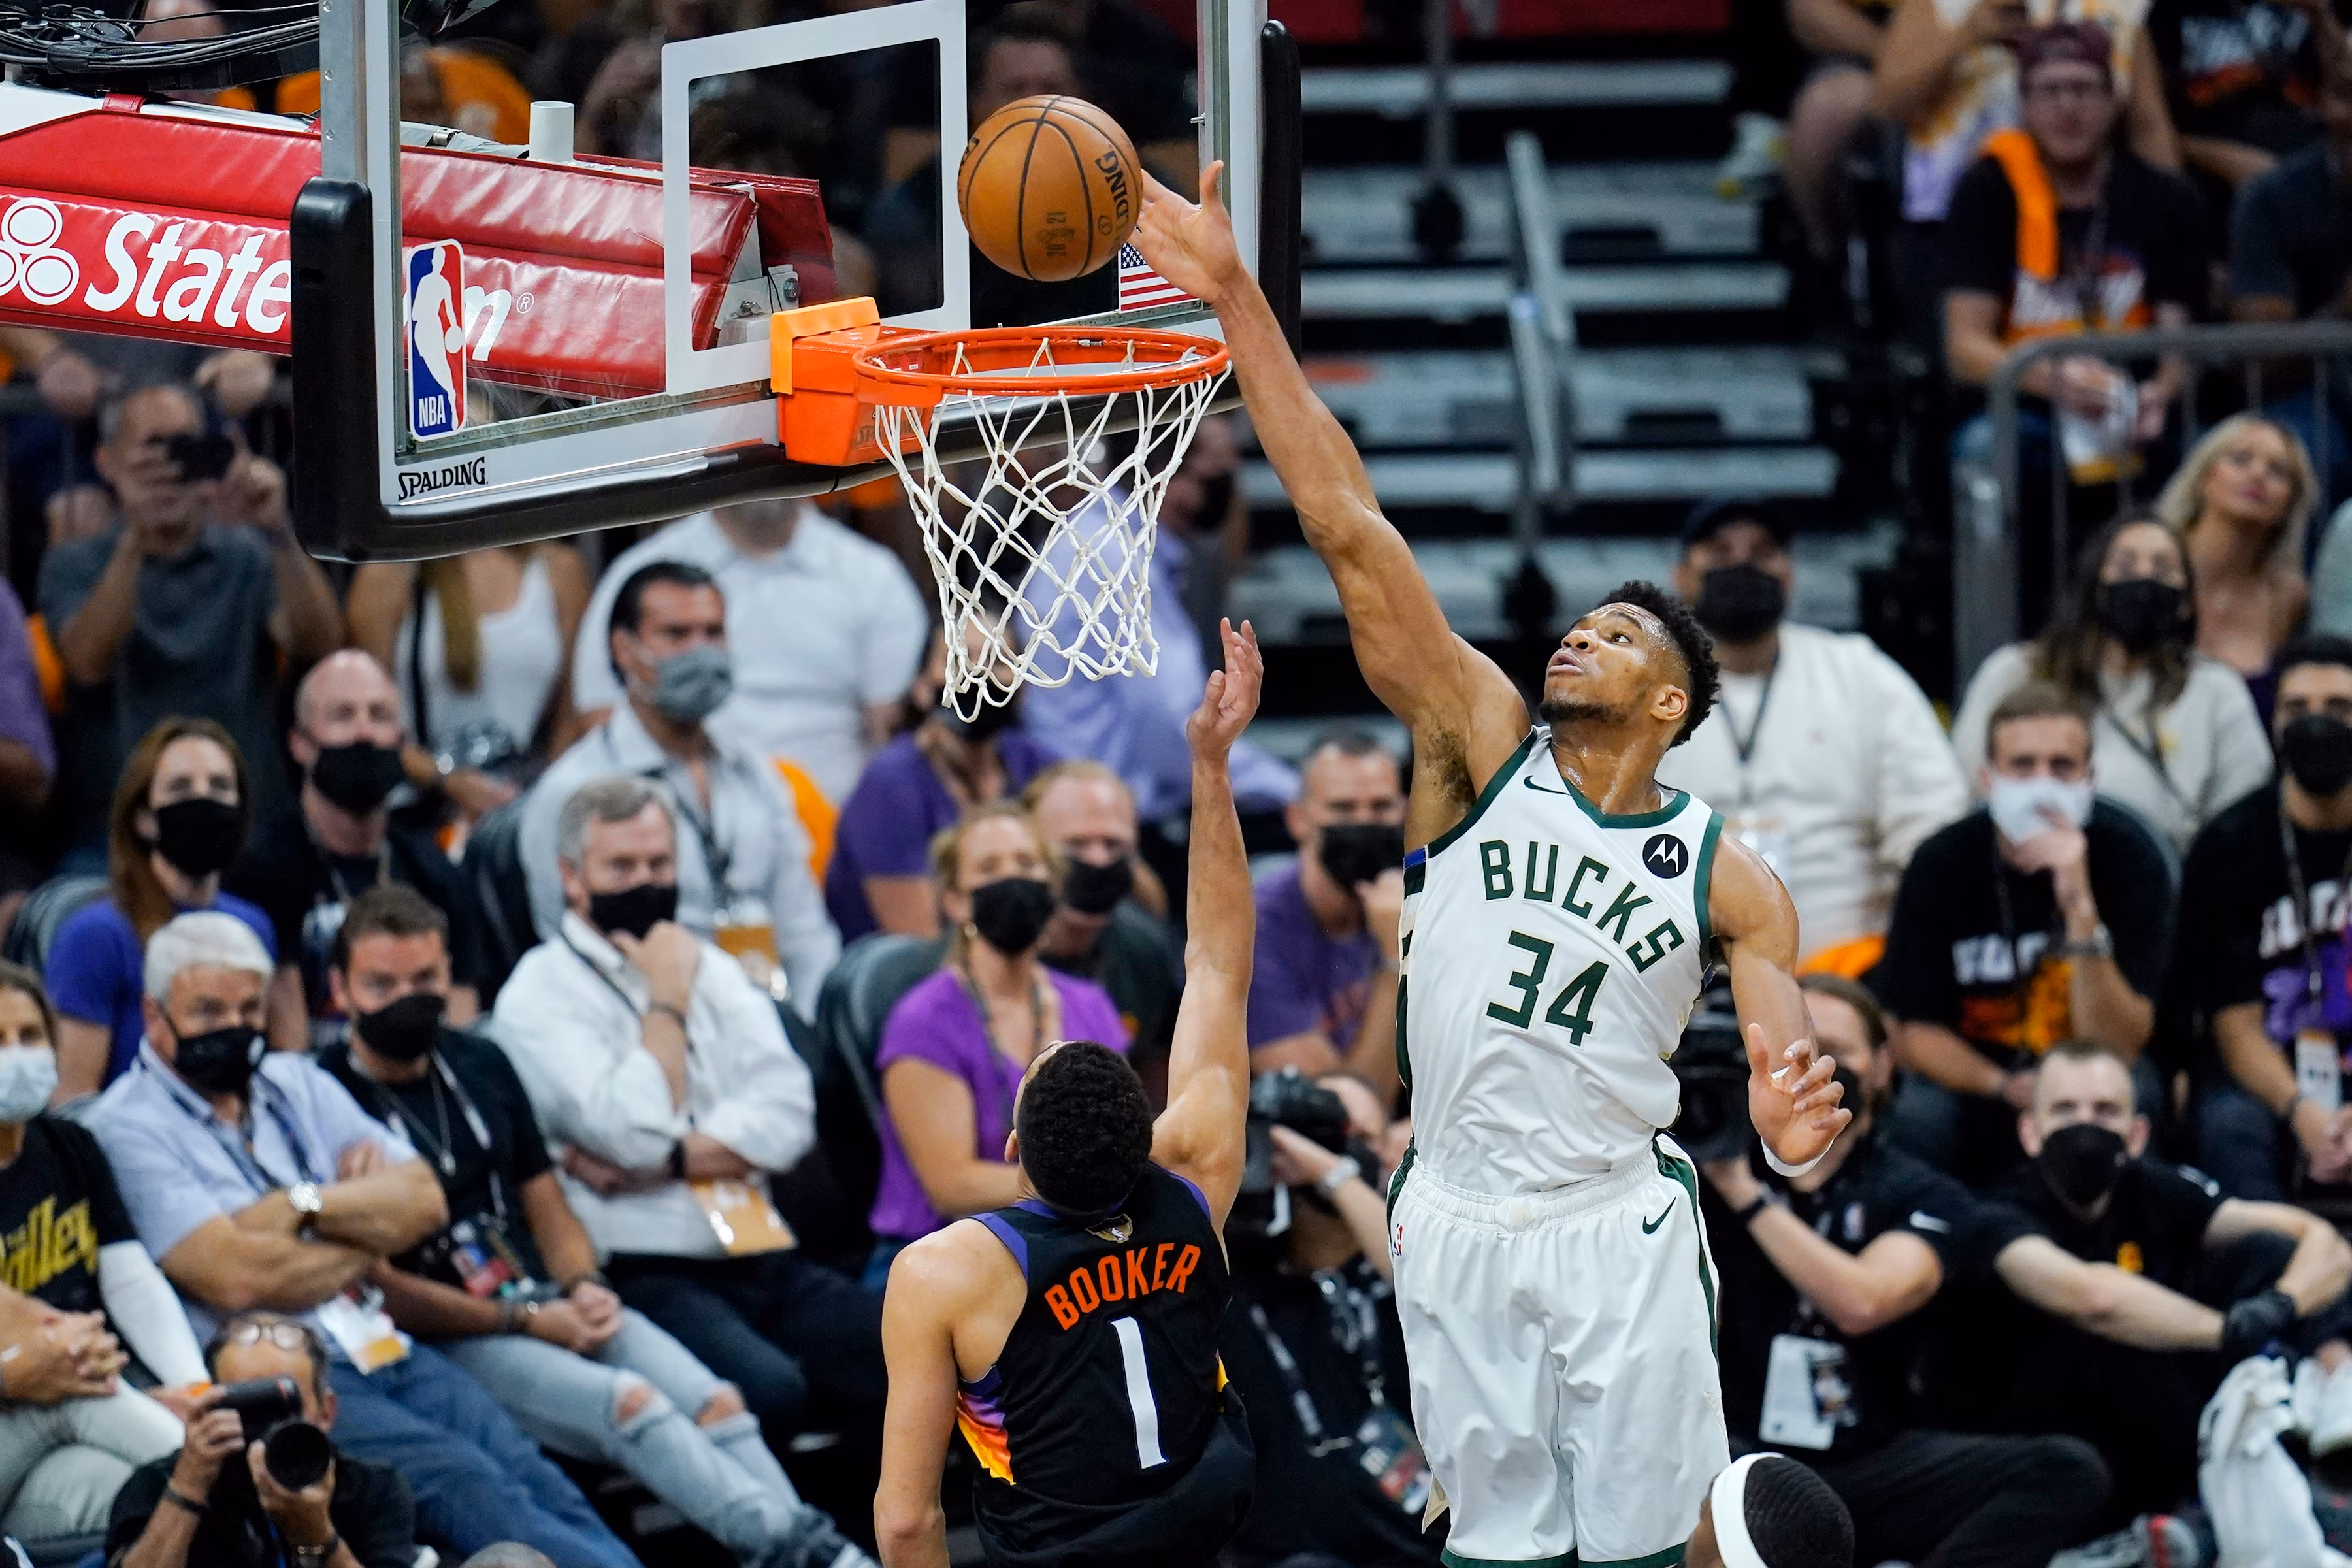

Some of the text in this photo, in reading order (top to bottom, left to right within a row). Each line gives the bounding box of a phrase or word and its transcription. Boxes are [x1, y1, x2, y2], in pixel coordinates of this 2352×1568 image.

[85, 214, 291, 333] State
[419, 394, 446, 428] NBA
[398, 456, 485, 501] SPALDING
[1480, 840, 1685, 974] BUCKS
[1486, 930, 1609, 1047] 34
[0, 1194, 98, 1292] alley
[1045, 1243, 1201, 1330] BOOKER
[1110, 1316, 1167, 1469] 1
